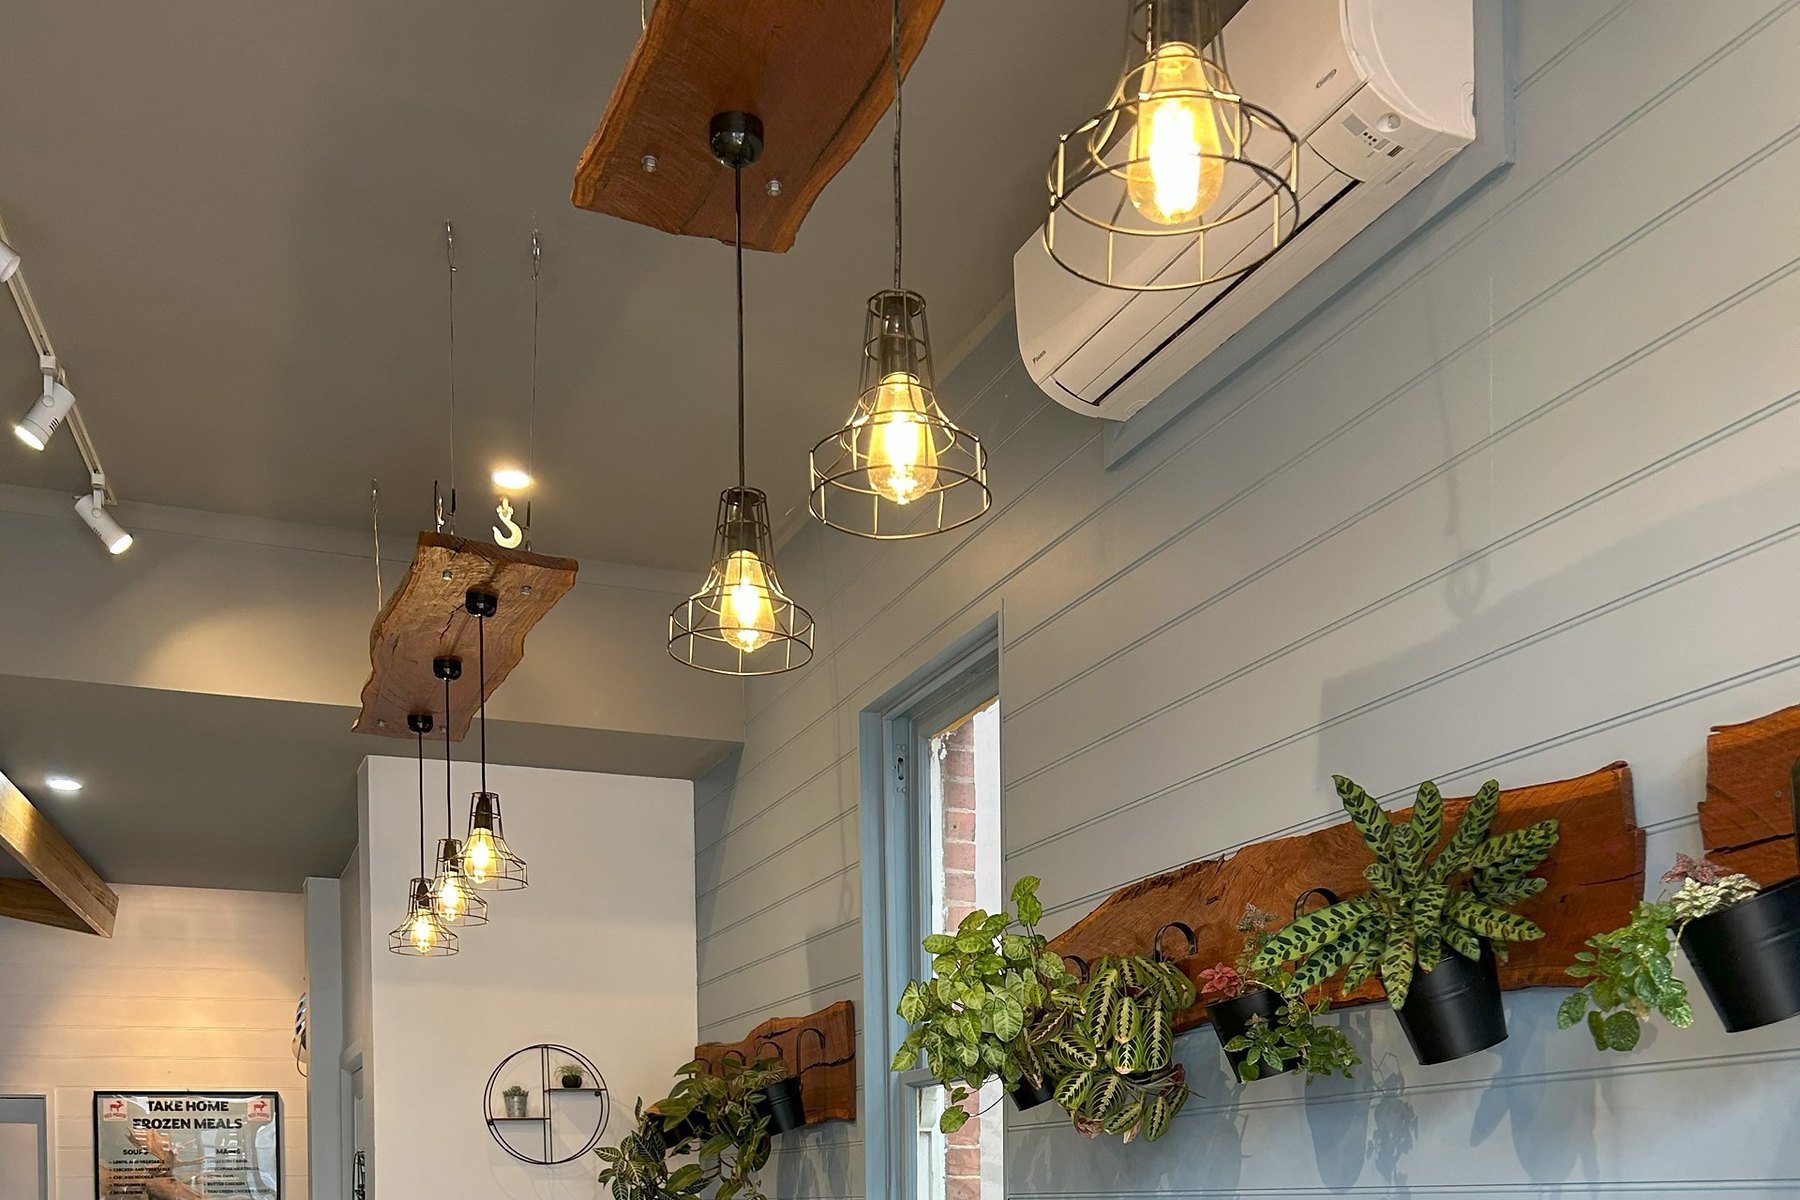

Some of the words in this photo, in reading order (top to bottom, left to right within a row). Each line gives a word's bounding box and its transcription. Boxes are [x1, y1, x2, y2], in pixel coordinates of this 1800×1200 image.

[147, 1101, 184, 1112] TAKE
[185, 1101, 230, 1112] HOME
[132, 1118, 191, 1130] FROZEN
[194, 1118, 243, 1130] MEALS
